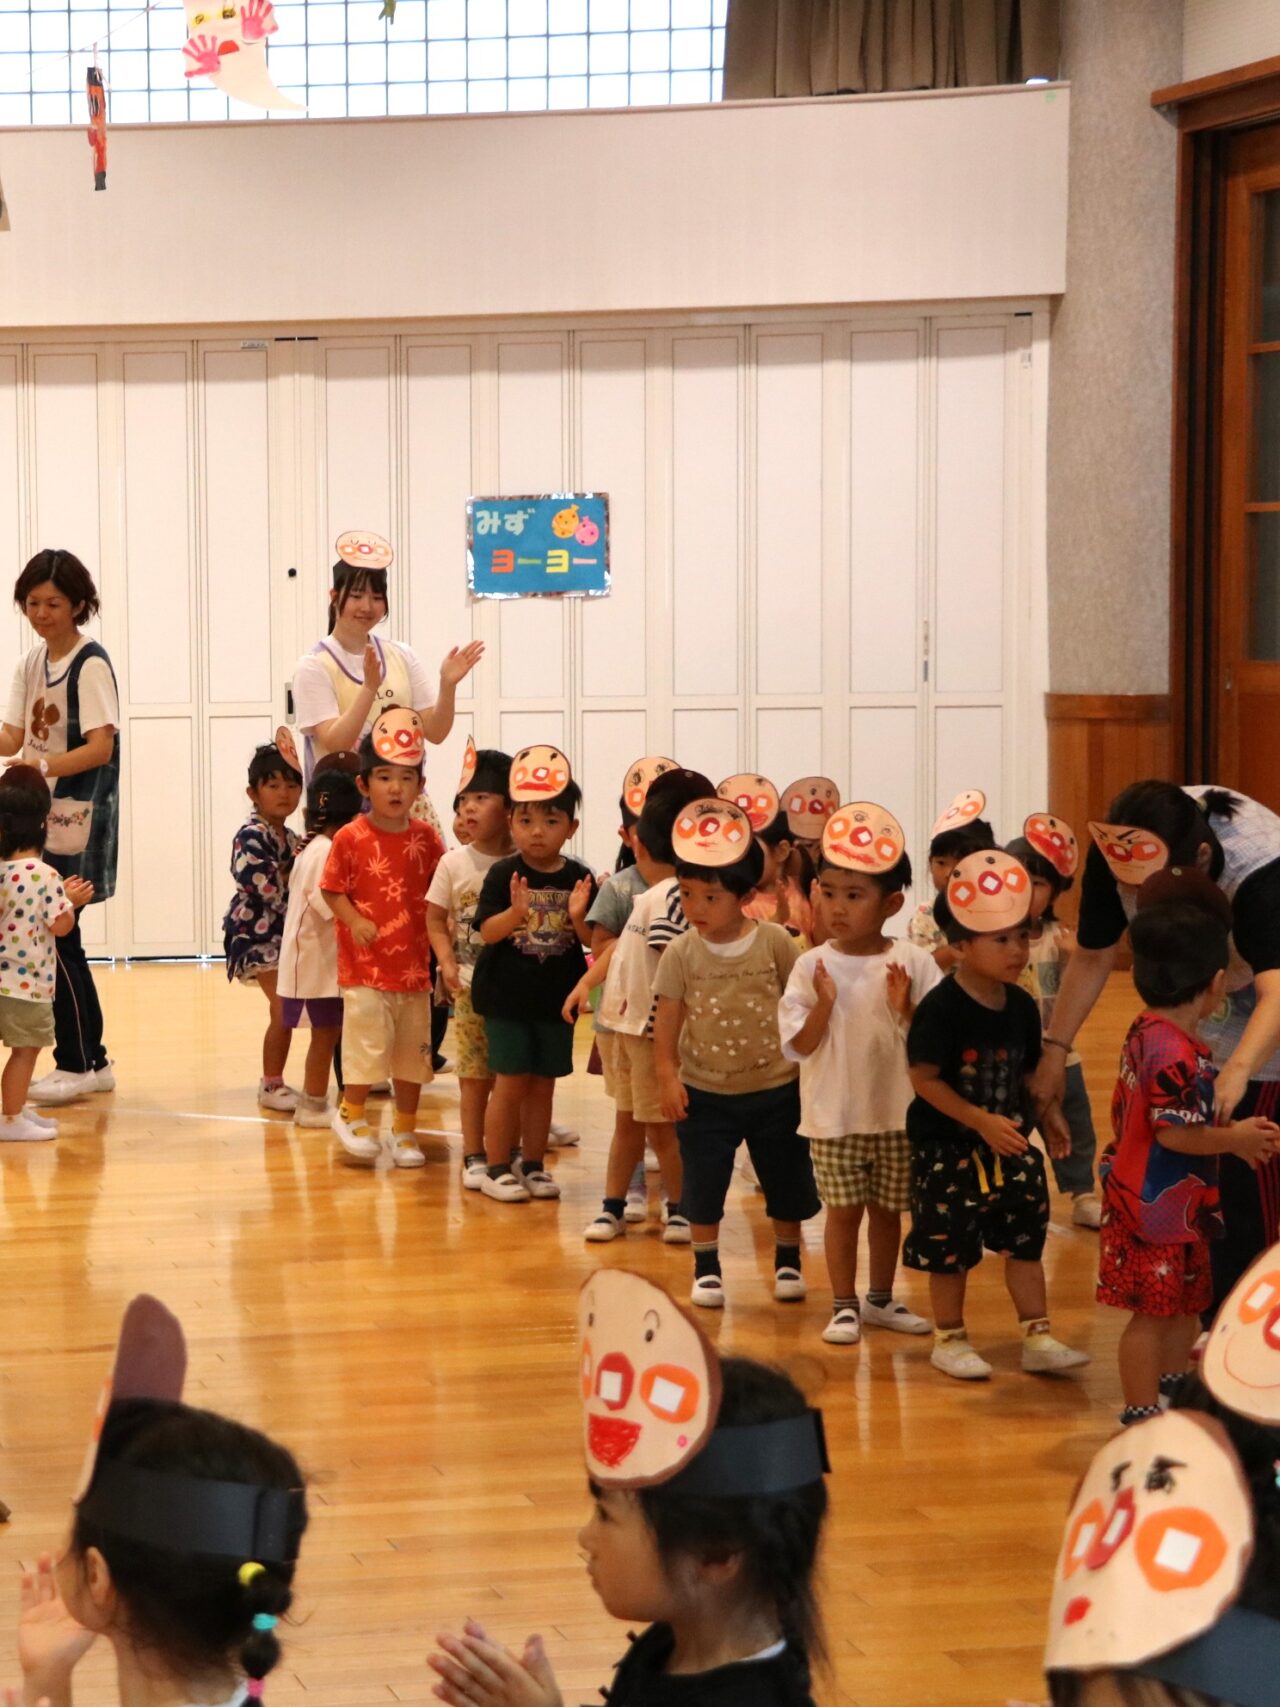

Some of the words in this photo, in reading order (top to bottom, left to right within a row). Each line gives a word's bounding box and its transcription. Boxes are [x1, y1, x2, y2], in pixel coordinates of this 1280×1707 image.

[475, 507, 536, 536] みず
[490, 549, 598, 574] ヨーヨー
